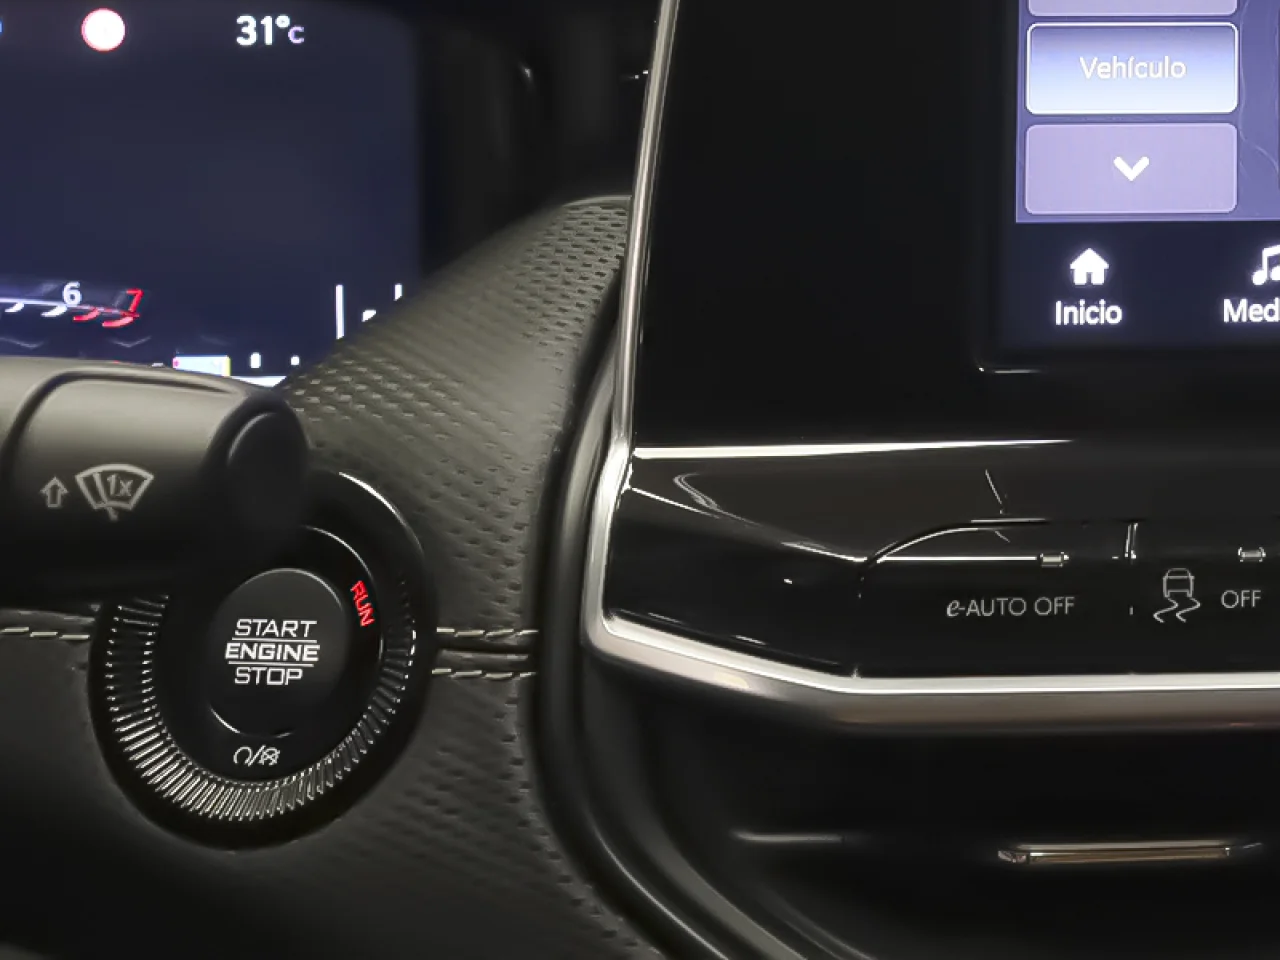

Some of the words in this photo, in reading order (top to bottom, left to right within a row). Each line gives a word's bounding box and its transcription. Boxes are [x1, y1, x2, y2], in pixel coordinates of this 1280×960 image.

[1080, 55, 1187, 79] Vehículo
[62, 281, 82, 306] 6
[126, 288, 144, 315] 7
[1055, 300, 1123, 325] Inicio
[350, 580, 375, 628] RUN
[946, 598, 1027, 617] e-AUTO
[1034, 597, 1075, 616] OFF
[1220, 589, 1262, 610] OFF
[234, 619, 317, 637] START
[225, 643, 320, 661] ENGINE
[234, 667, 303, 685] STOP
